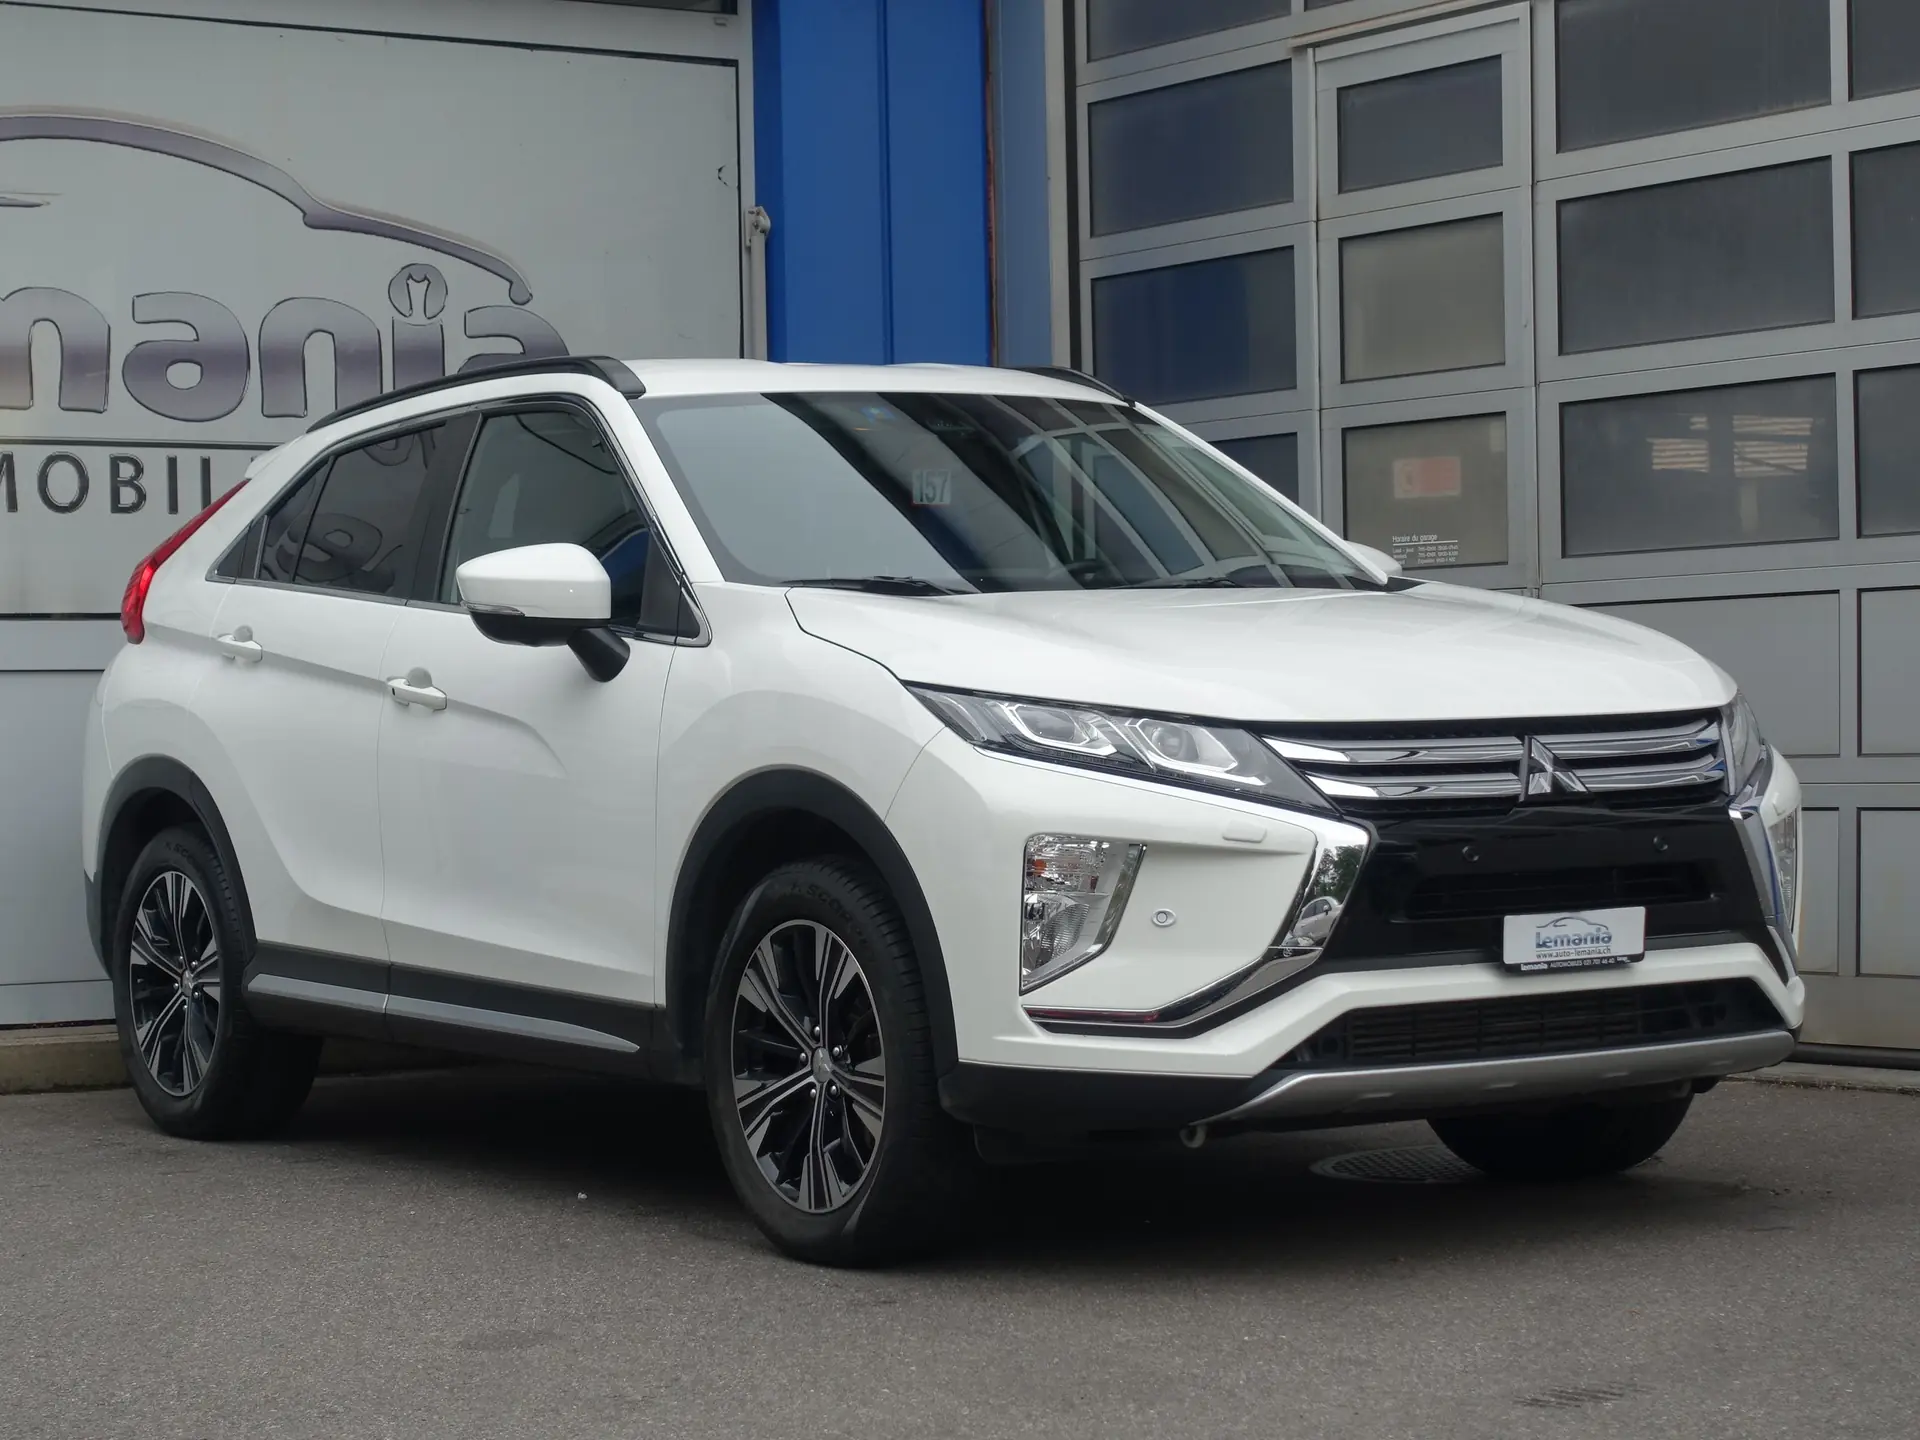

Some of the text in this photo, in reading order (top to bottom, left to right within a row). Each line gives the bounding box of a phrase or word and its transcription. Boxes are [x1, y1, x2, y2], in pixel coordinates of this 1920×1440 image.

[917, 470, 949, 504] 157
[1412, 534, 1418, 542] du
[1536, 947, 1611, 959] www.auto-lemania.ch
